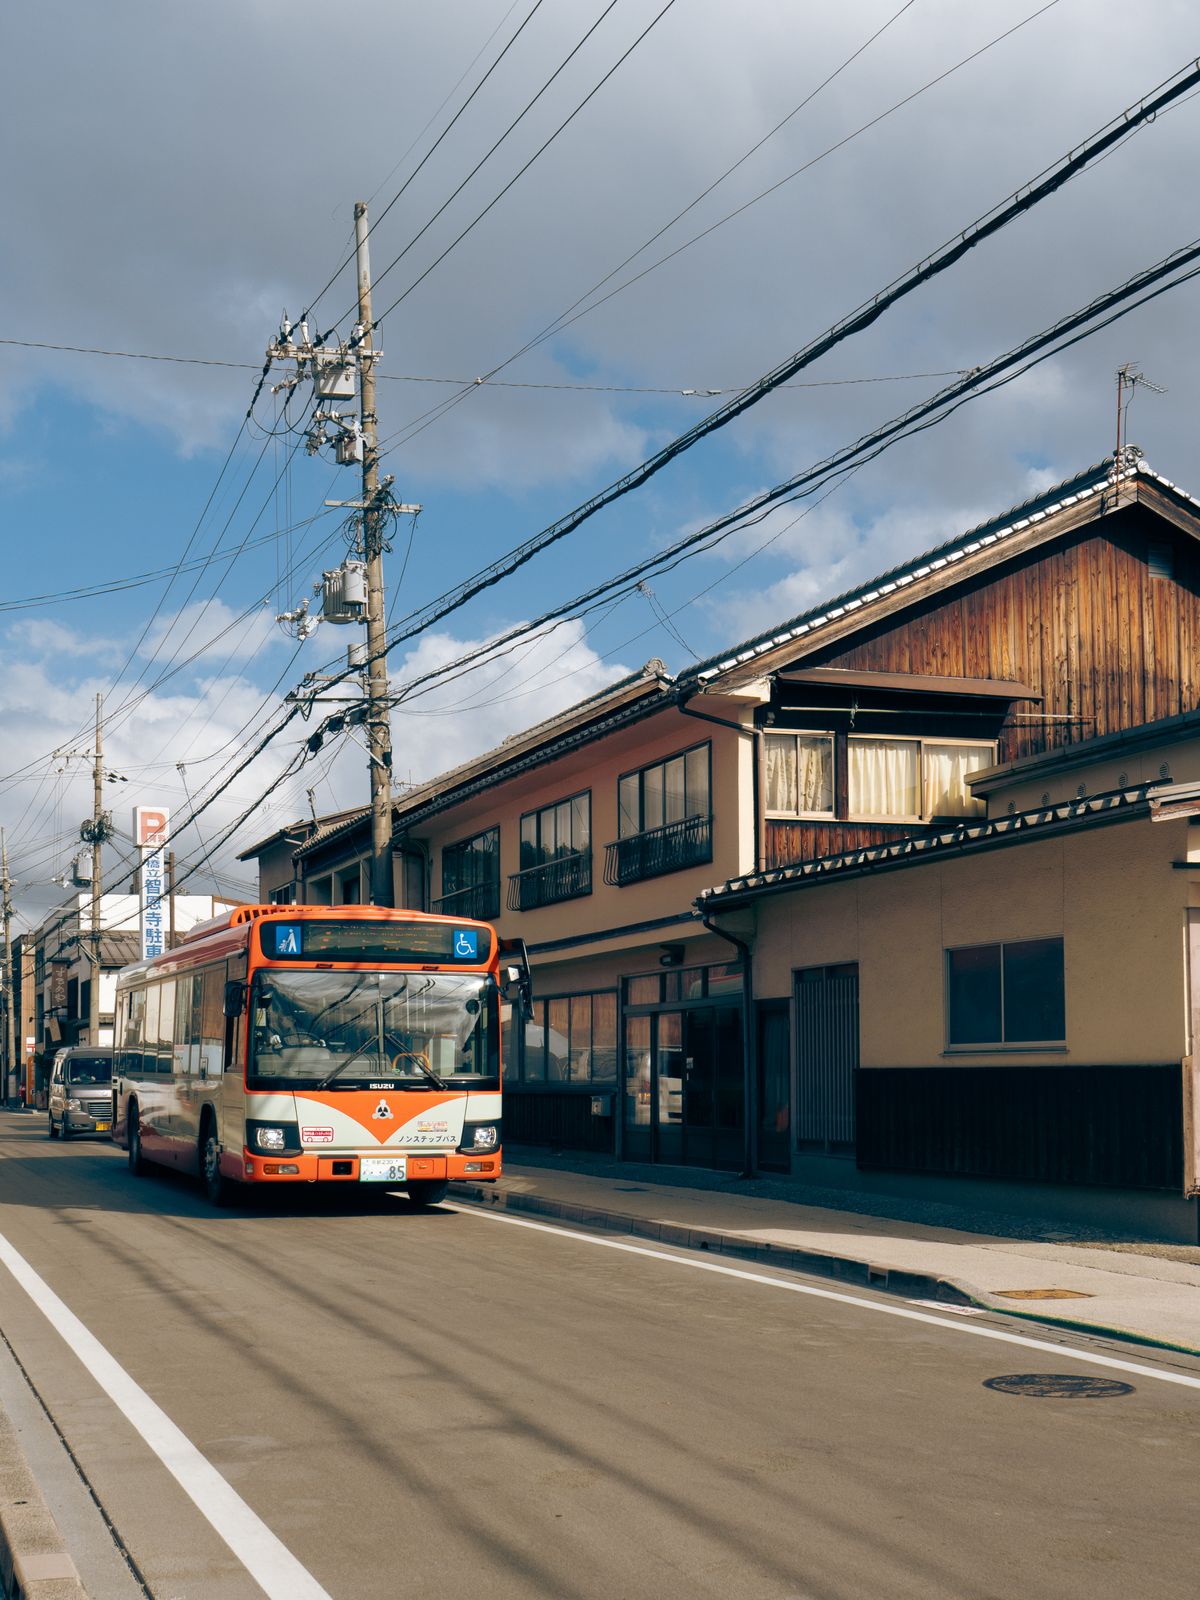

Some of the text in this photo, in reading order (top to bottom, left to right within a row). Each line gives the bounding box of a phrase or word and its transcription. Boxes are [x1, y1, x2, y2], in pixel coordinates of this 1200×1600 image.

[141, 812, 166, 843] P
[398, 1135, 457, 1143] ノンステップバス
